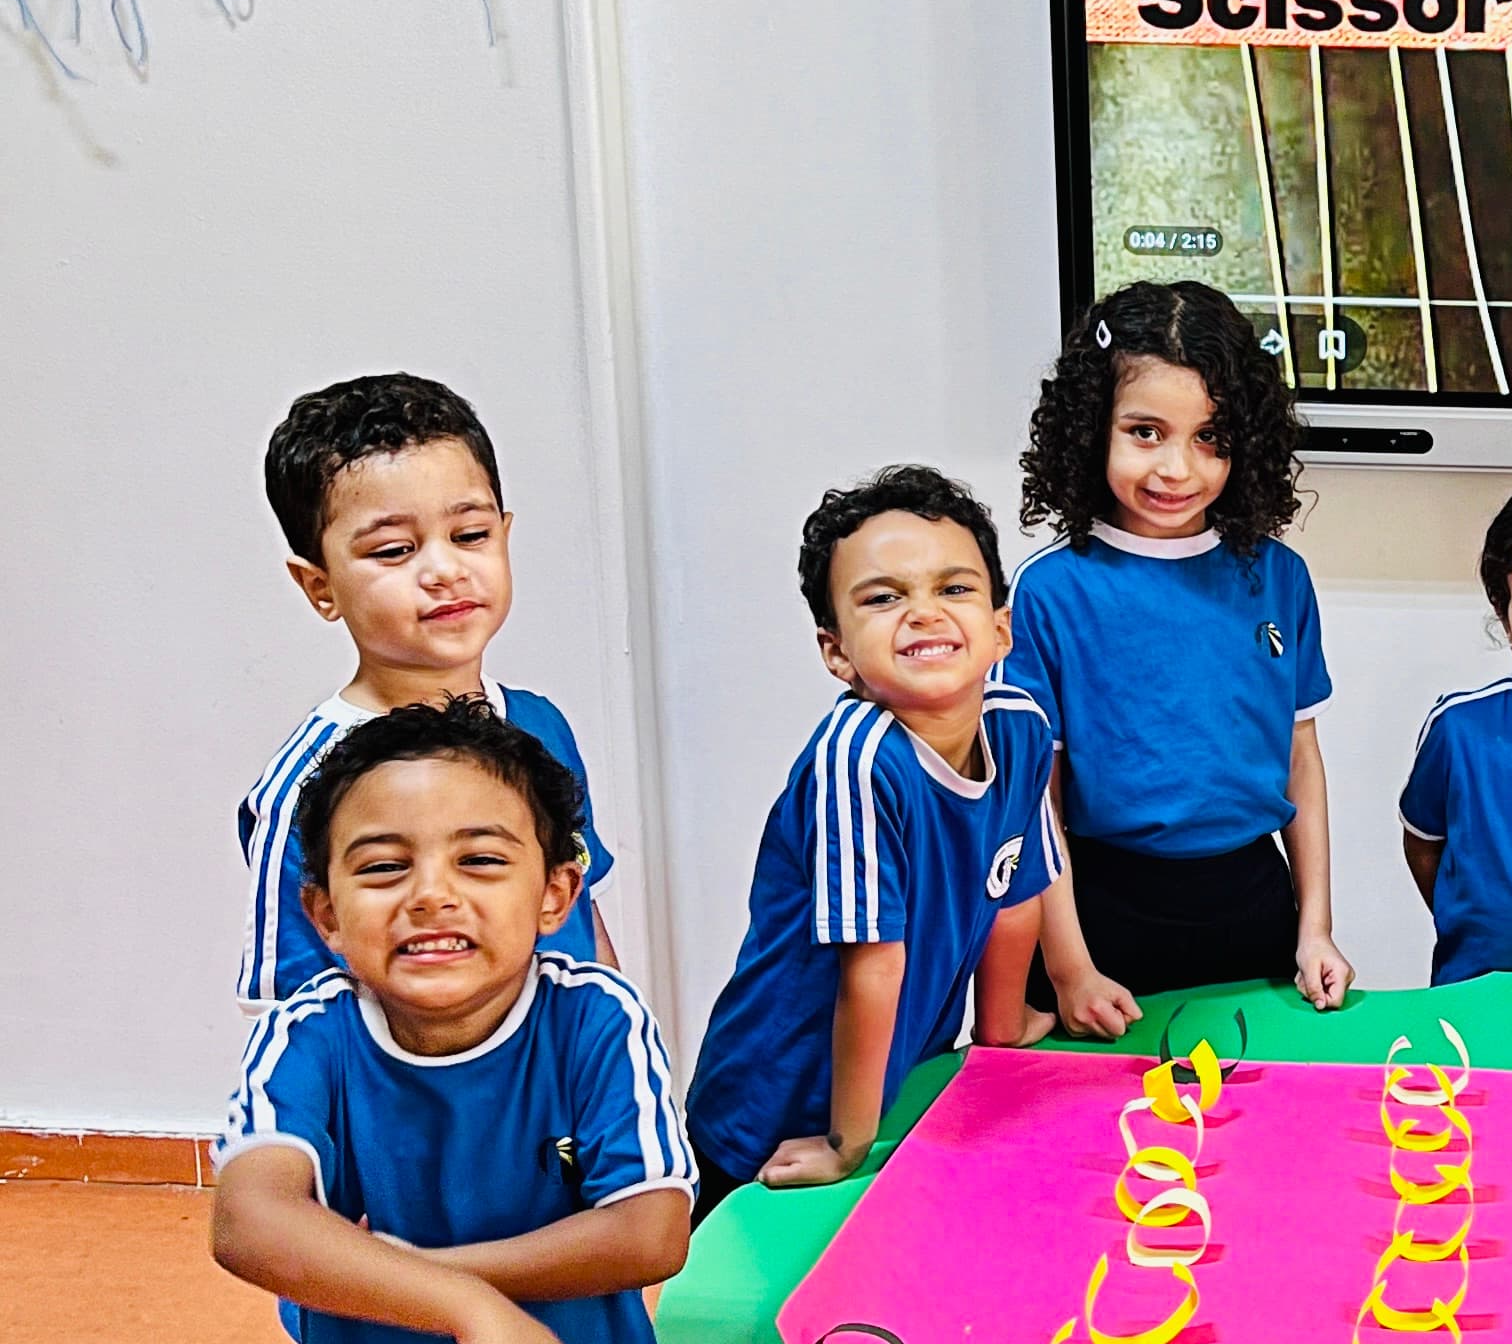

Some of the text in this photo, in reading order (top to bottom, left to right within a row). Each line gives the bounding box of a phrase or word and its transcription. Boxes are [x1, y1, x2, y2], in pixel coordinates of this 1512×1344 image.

[1129, 231, 1217, 250] 0:04 / 2:15
